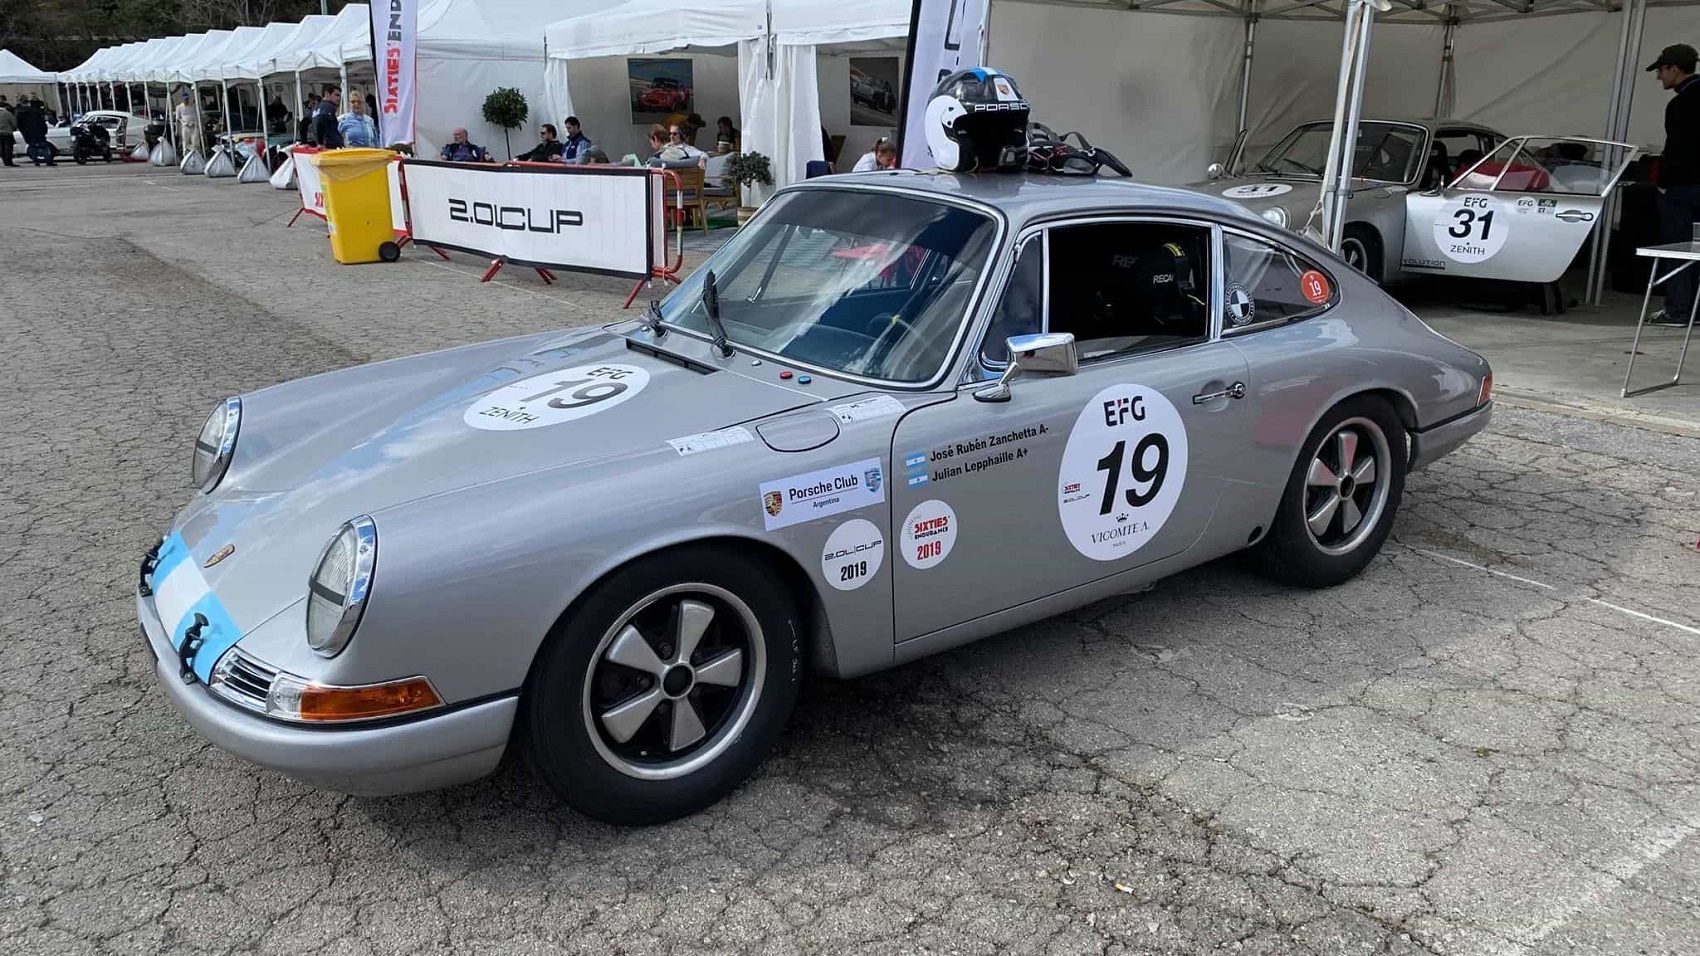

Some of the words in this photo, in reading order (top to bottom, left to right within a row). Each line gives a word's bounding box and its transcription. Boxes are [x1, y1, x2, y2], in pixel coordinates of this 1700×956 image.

[1464, 196, 1489, 208] EFG
[1448, 208, 1495, 241] 31
[1450, 245, 1486, 256] ZENITH
[1308, 280, 1323, 297] 19
[586, 366, 634, 381] EFG
[519, 378, 629, 410] 19
[479, 406, 540, 425] ZENITH
[1103, 395, 1146, 427] EFG
[930, 445, 954, 462] José
[956, 438, 987, 455] Rubén
[989, 427, 1037, 447] Zanchetta
[932, 465, 962, 482] Julian
[964, 450, 1014, 473] Lepphaille
[1096, 432, 1170, 516] 19
[788, 481, 833, 502] Porsche
[834, 474, 859, 490] Club
[812, 496, 841, 509] Argentina
[914, 526, 949, 540] ENDURANCE
[1090, 522, 1140, 545] VICOMTE
[917, 540, 942, 561] 2019
[840, 560, 868, 582] 2019
